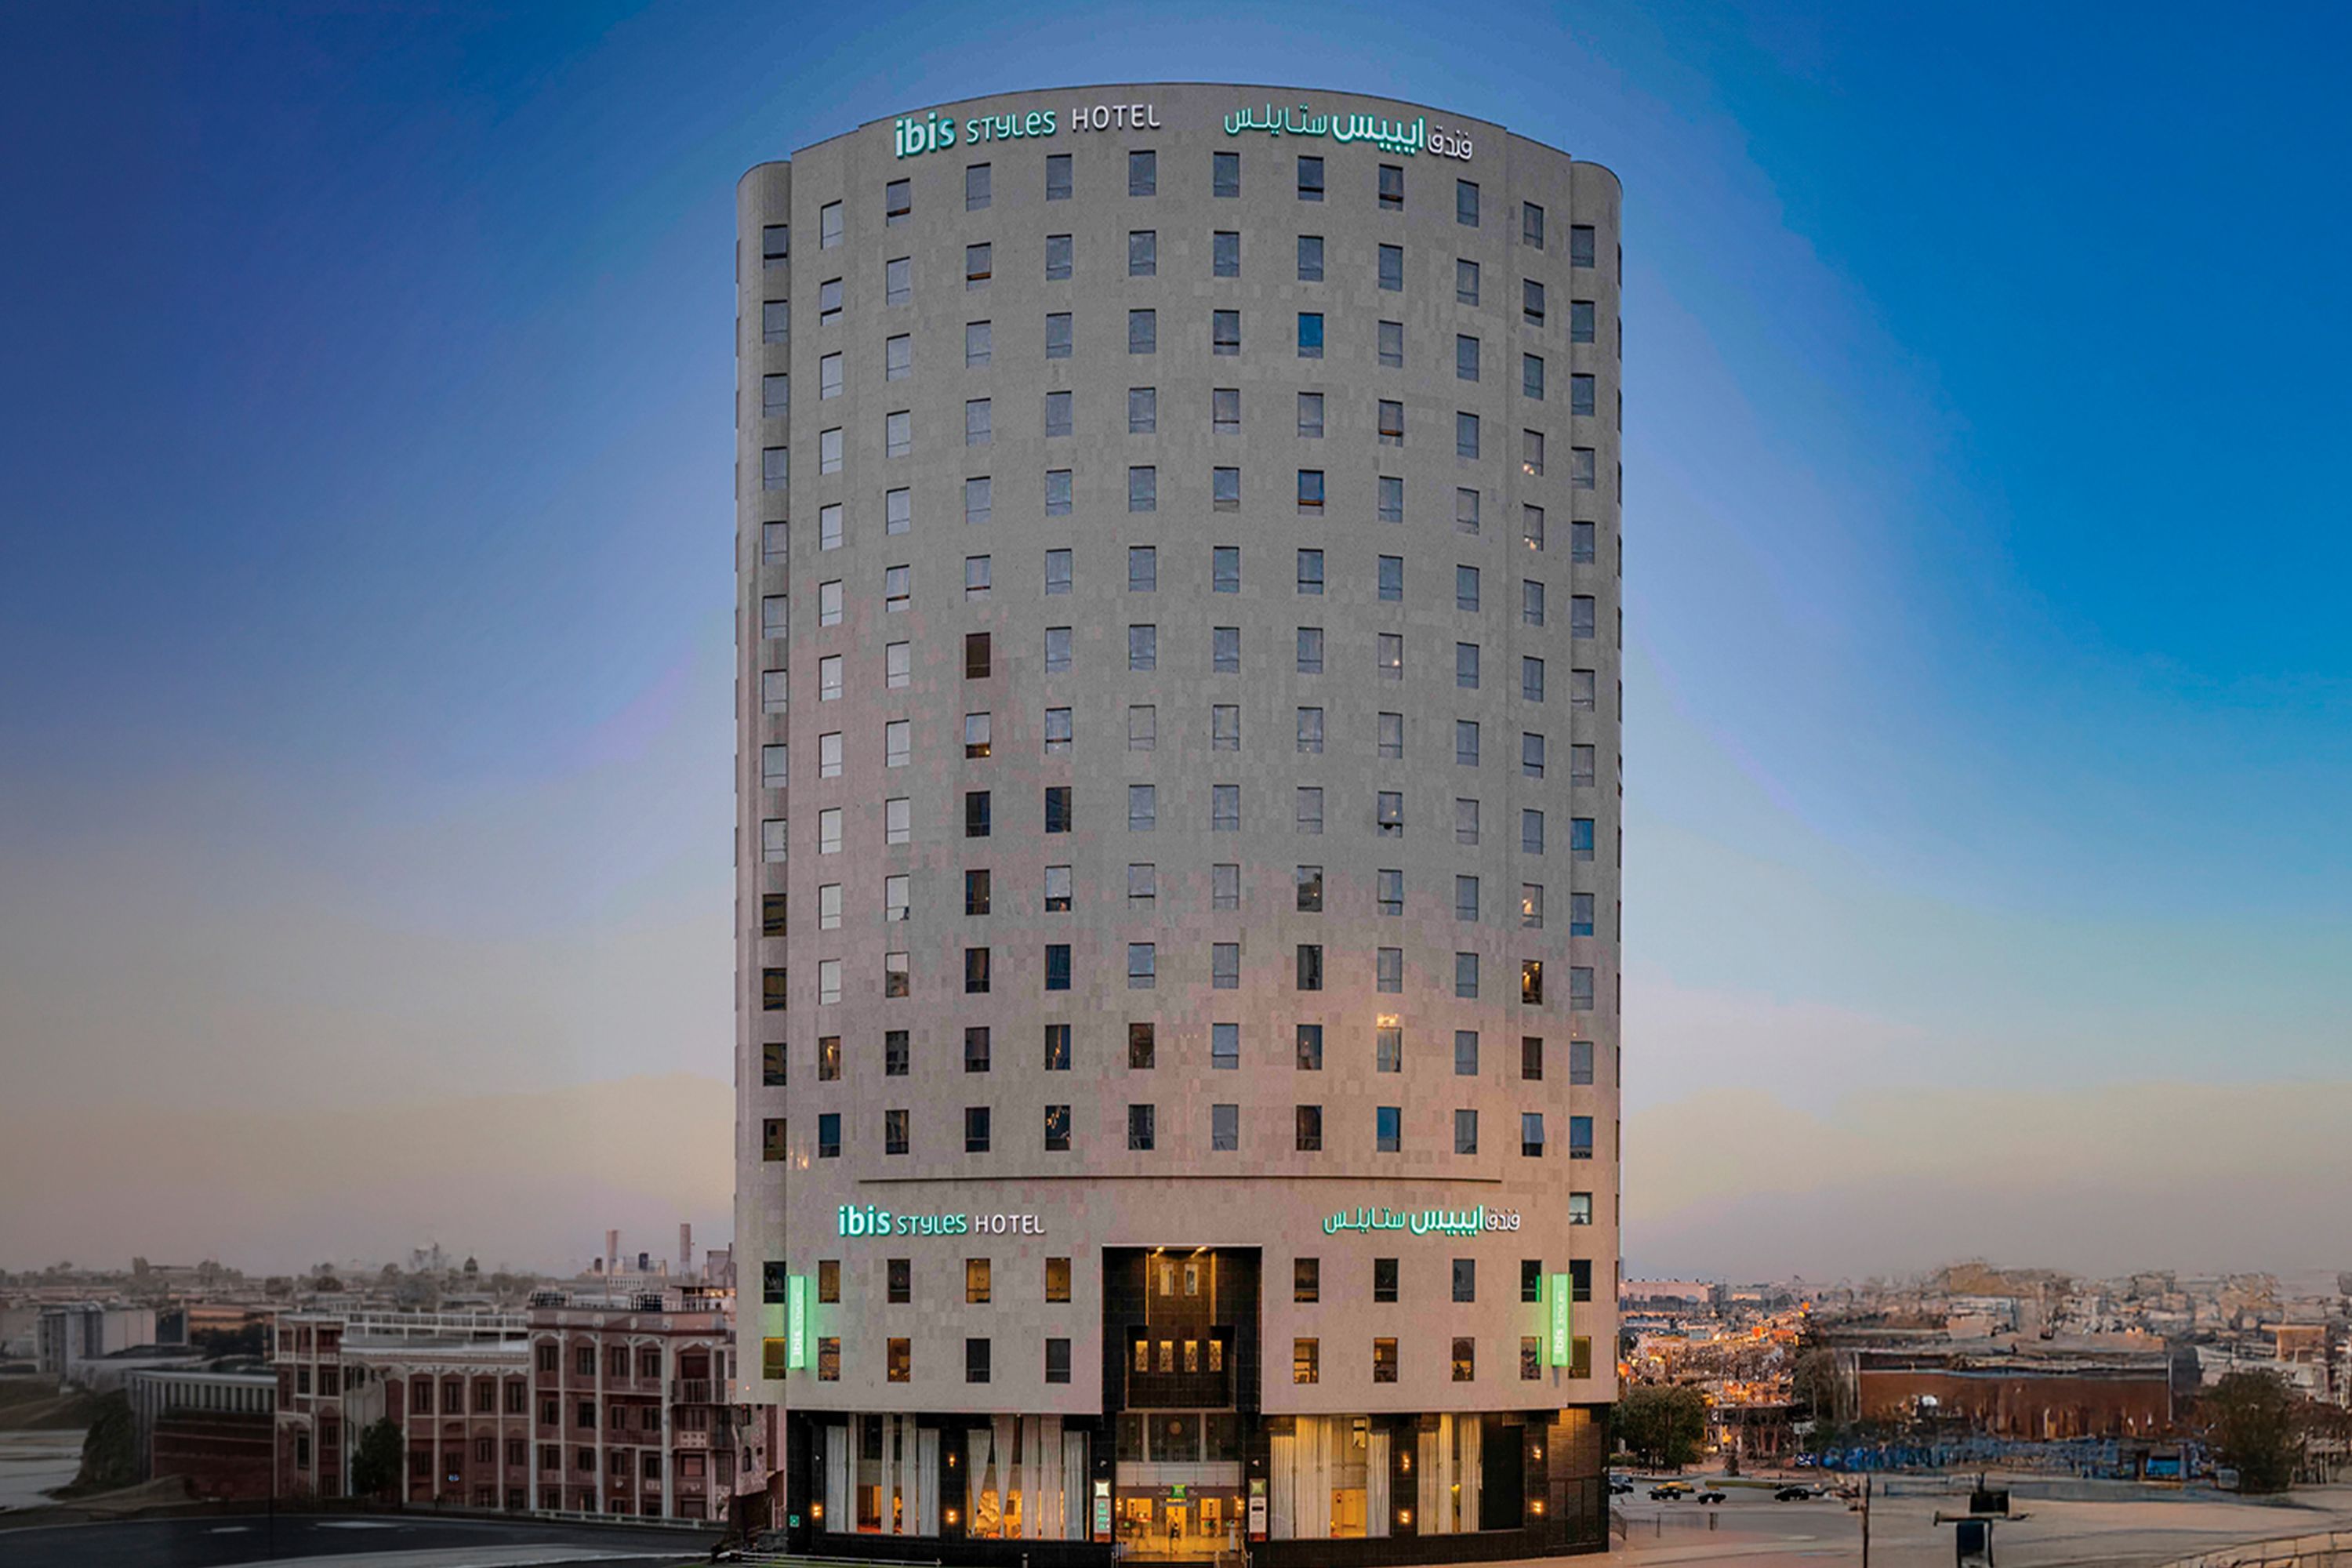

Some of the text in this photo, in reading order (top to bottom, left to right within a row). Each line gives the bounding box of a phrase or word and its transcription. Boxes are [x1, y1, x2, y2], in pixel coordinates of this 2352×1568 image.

[895, 111, 956, 158] ibis
[1072, 104, 1160, 131] HOTEL
[1225, 103, 1472, 160] فندق ايبيس ستايلس
[839, 1205, 891, 1236] ibis
[975, 1214, 1045, 1234] HOTEL
[1485, 1208, 1520, 1230] فندق
[1555, 1329, 1564, 1354] ibis
